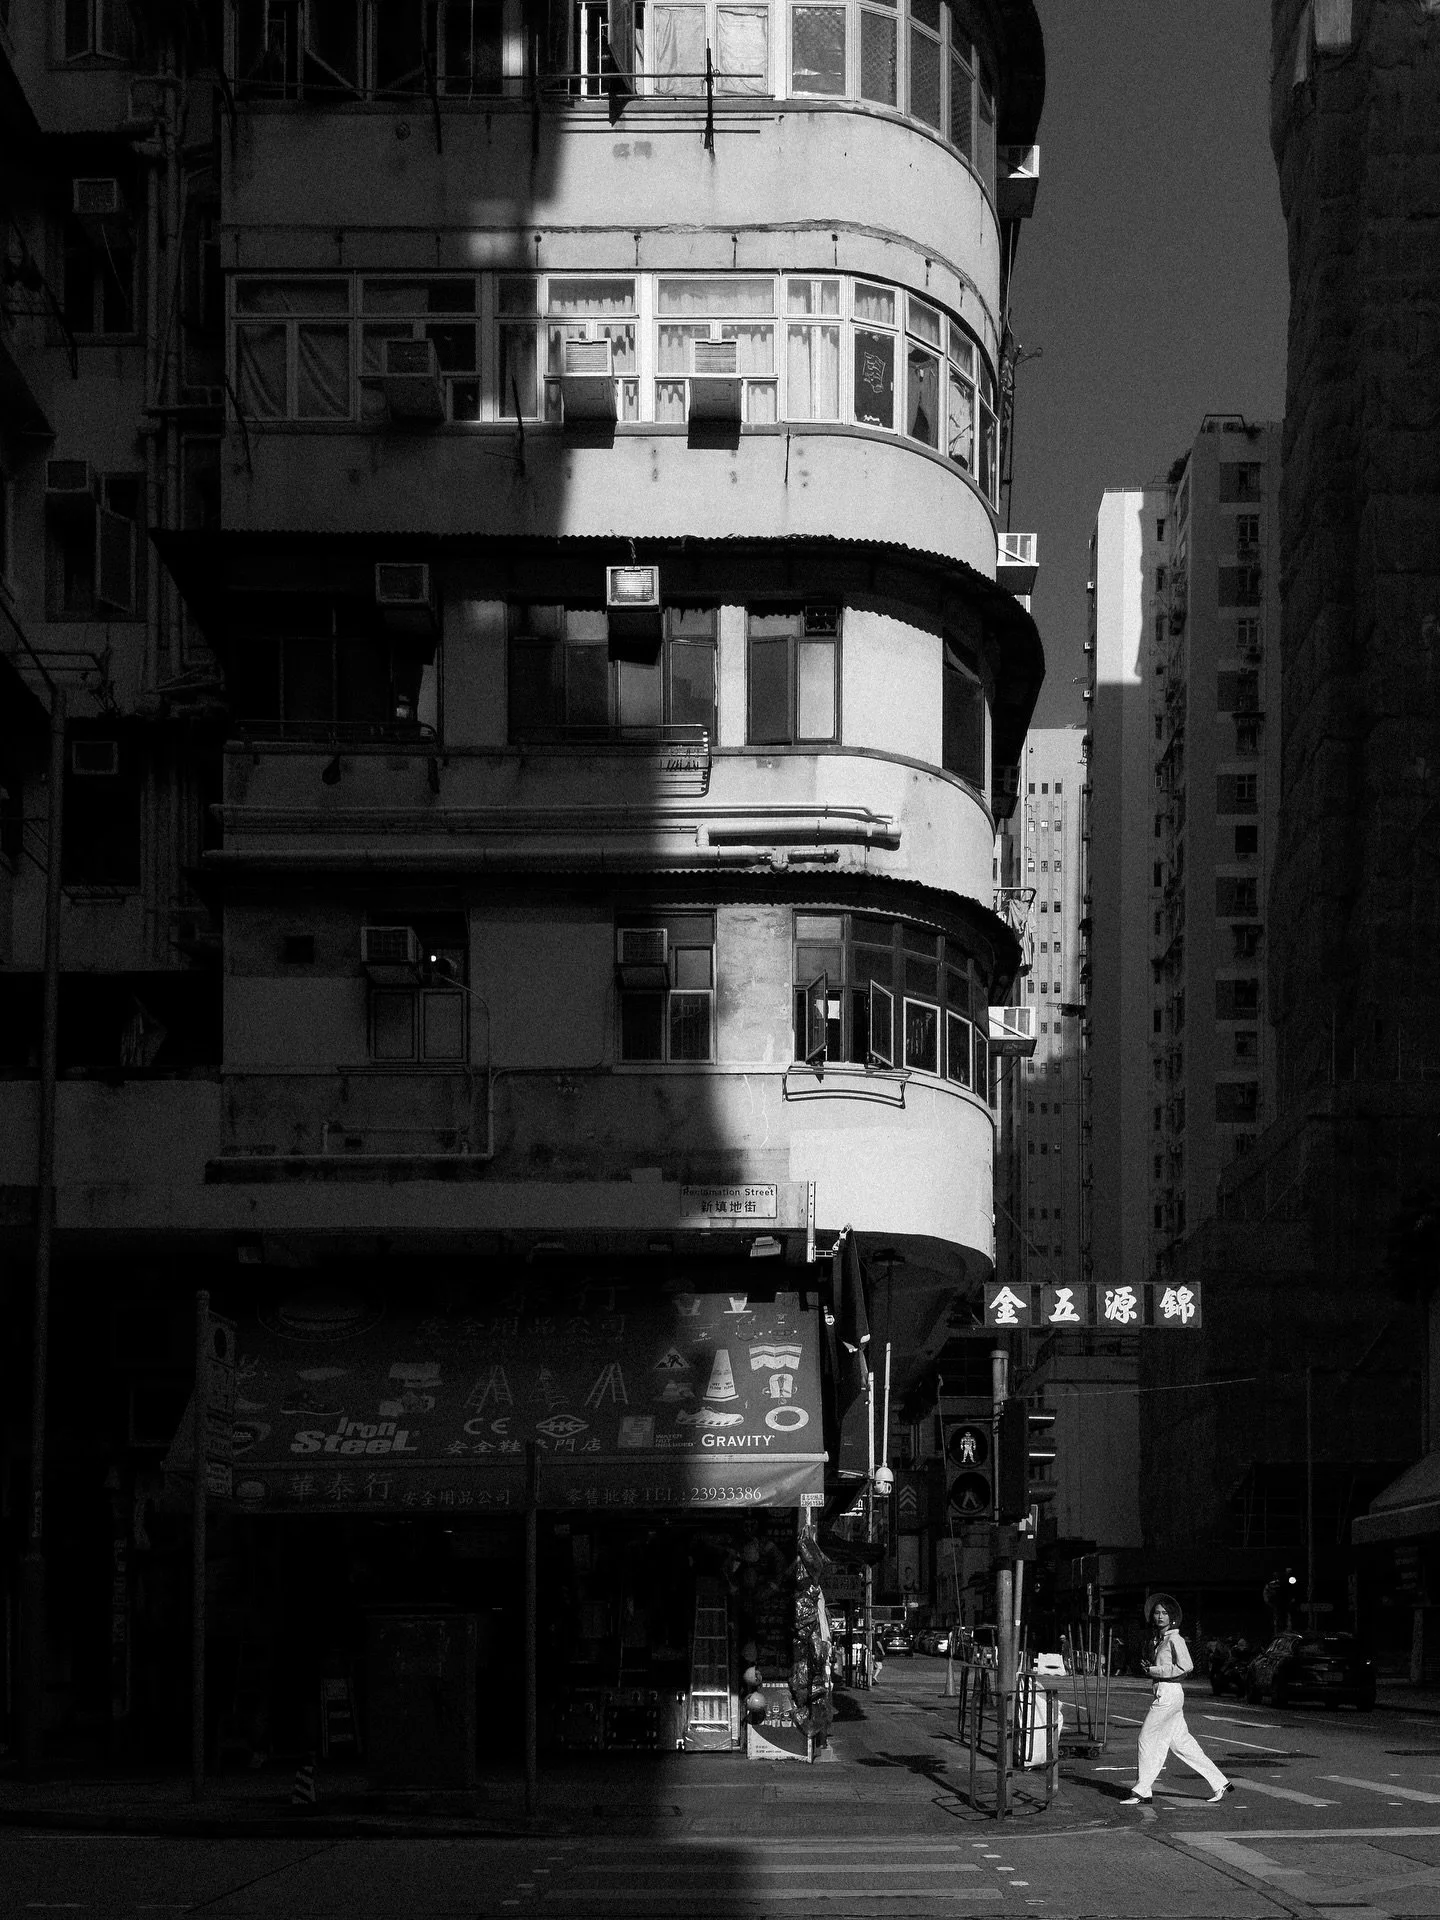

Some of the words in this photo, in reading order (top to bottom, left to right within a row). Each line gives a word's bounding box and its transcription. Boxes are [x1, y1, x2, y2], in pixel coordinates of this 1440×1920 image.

[745, 1187, 775, 1197] Street
[701, 1200, 757, 1213] 新填地街
[336, 1417, 396, 1436] Iron
[464, 1417, 510, 1435] CE
[702, 1433, 772, 1447] GRAVITY
[287, 1470, 393, 1501] 華泰行
[401, 1489, 511, 1506] 安全用品公司
[566, 1488, 638, 1505] 零售批發
[691, 1486, 762, 1501] 23933386
